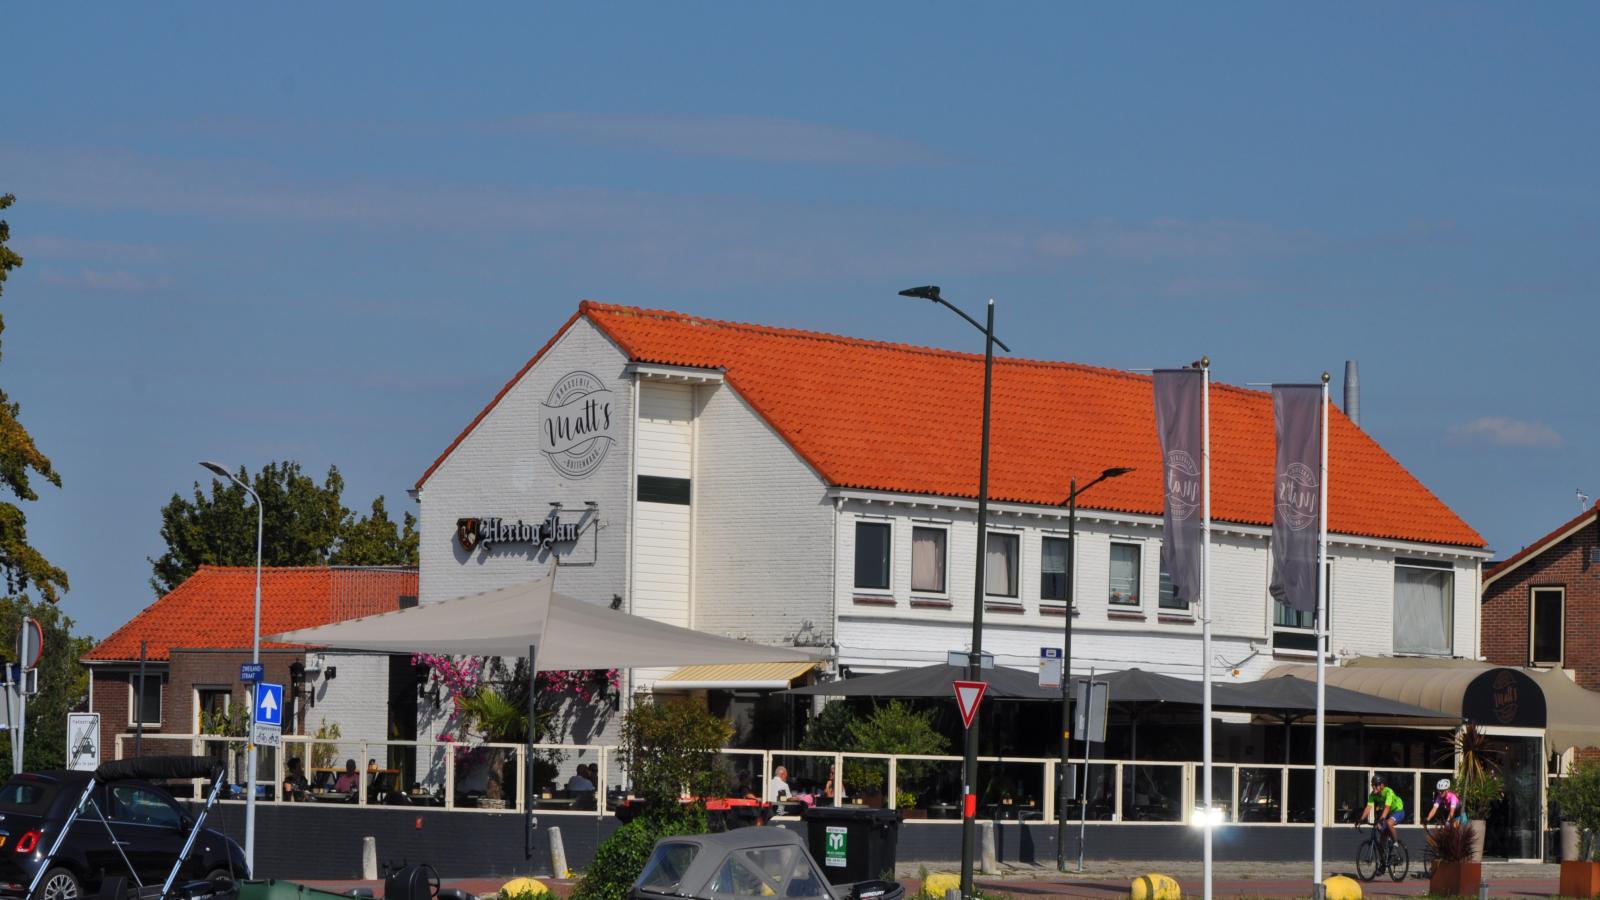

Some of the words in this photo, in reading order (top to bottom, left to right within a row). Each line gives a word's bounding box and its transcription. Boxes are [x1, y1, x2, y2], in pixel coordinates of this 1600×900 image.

[544, 399, 612, 447] Matt's
[480, 517, 541, 550] Hertog
[543, 516, 578, 549] Jan
